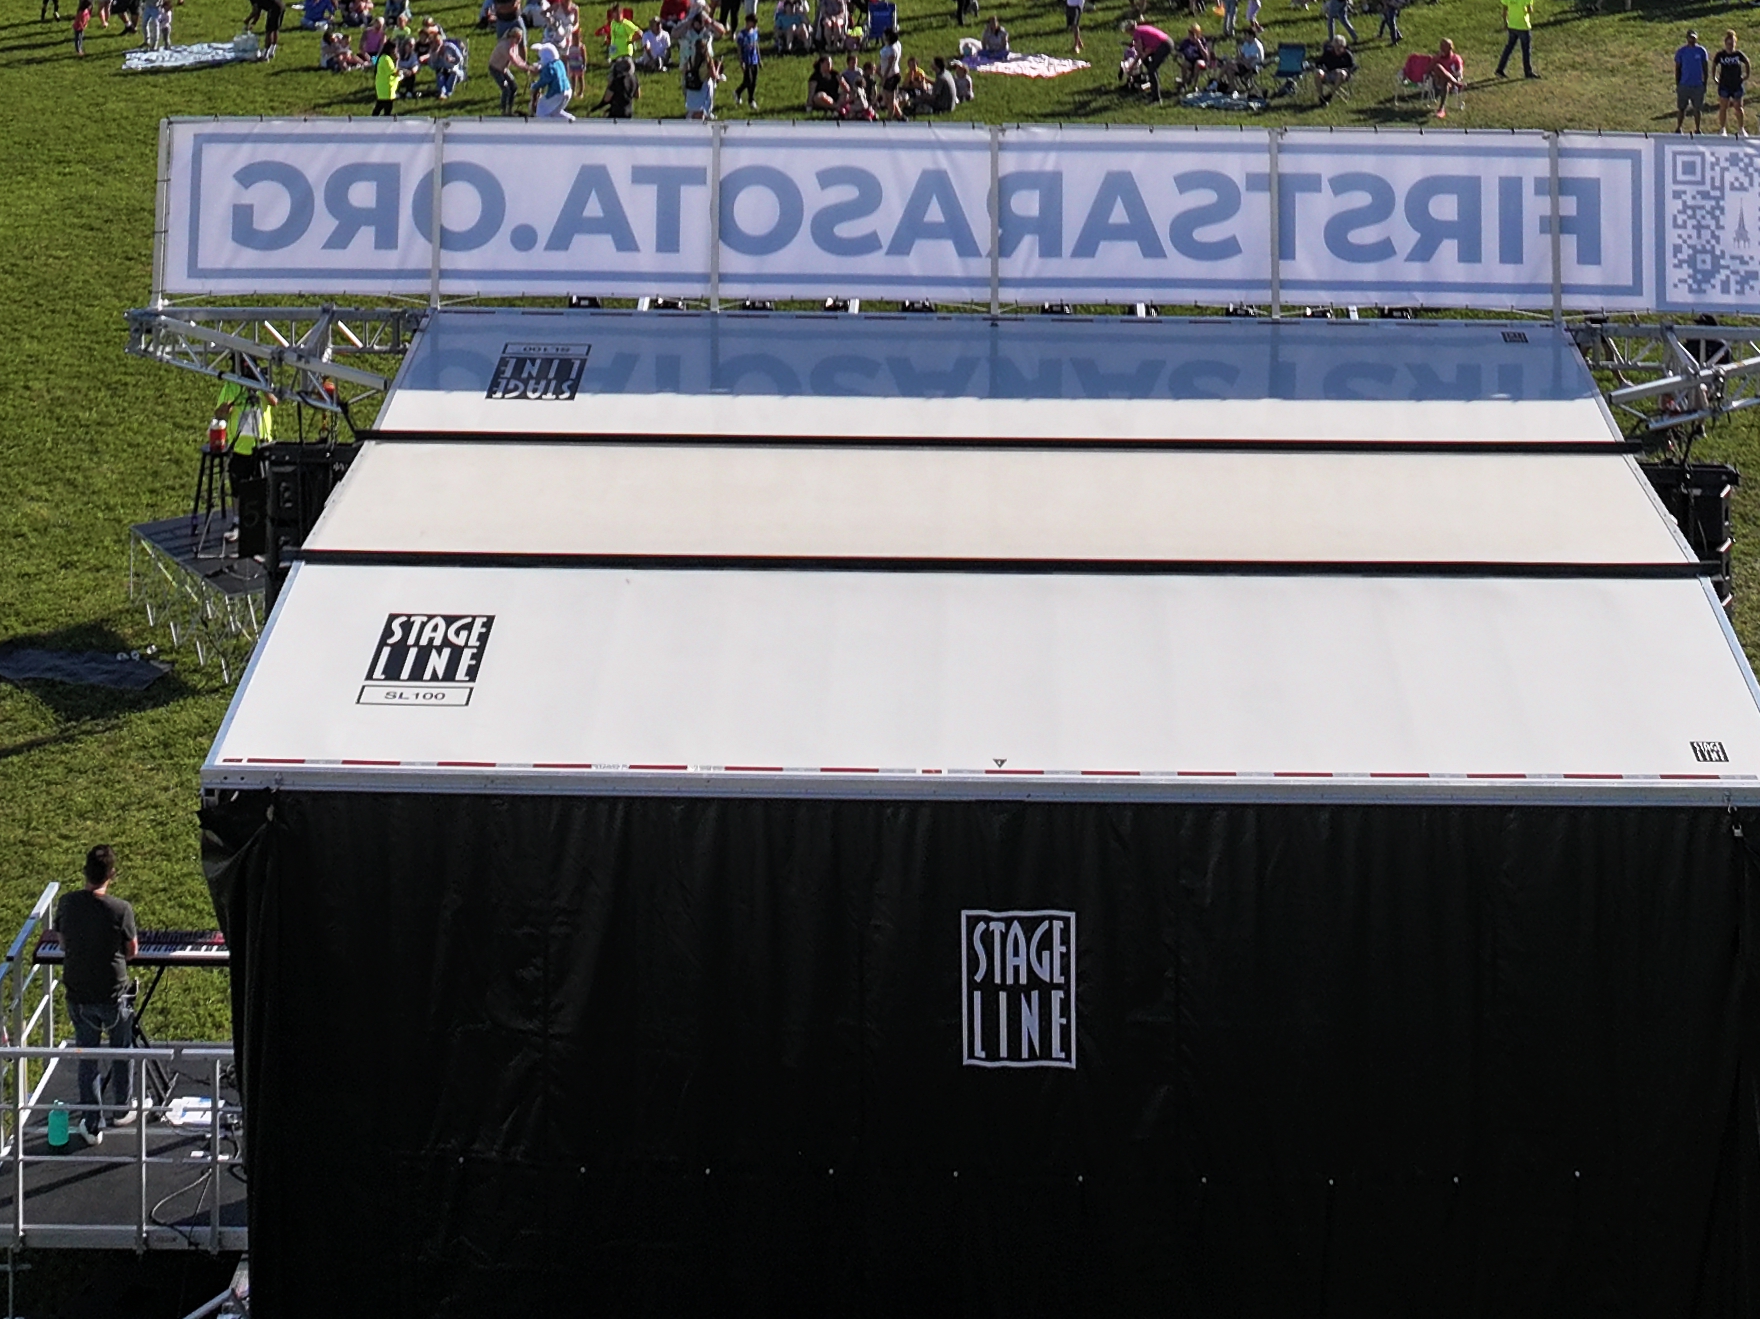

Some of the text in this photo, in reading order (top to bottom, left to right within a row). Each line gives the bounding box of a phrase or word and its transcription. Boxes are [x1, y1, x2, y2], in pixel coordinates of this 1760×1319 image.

[501, 358, 581, 379] LINE
[492, 379, 573, 399] STAGE
[386, 615, 487, 647] STAGE
[372, 646, 478, 681] LINE
[384, 691, 446, 701] SL100
[973, 919, 1067, 985] STAGE
[973, 989, 1067, 1059] LINE
